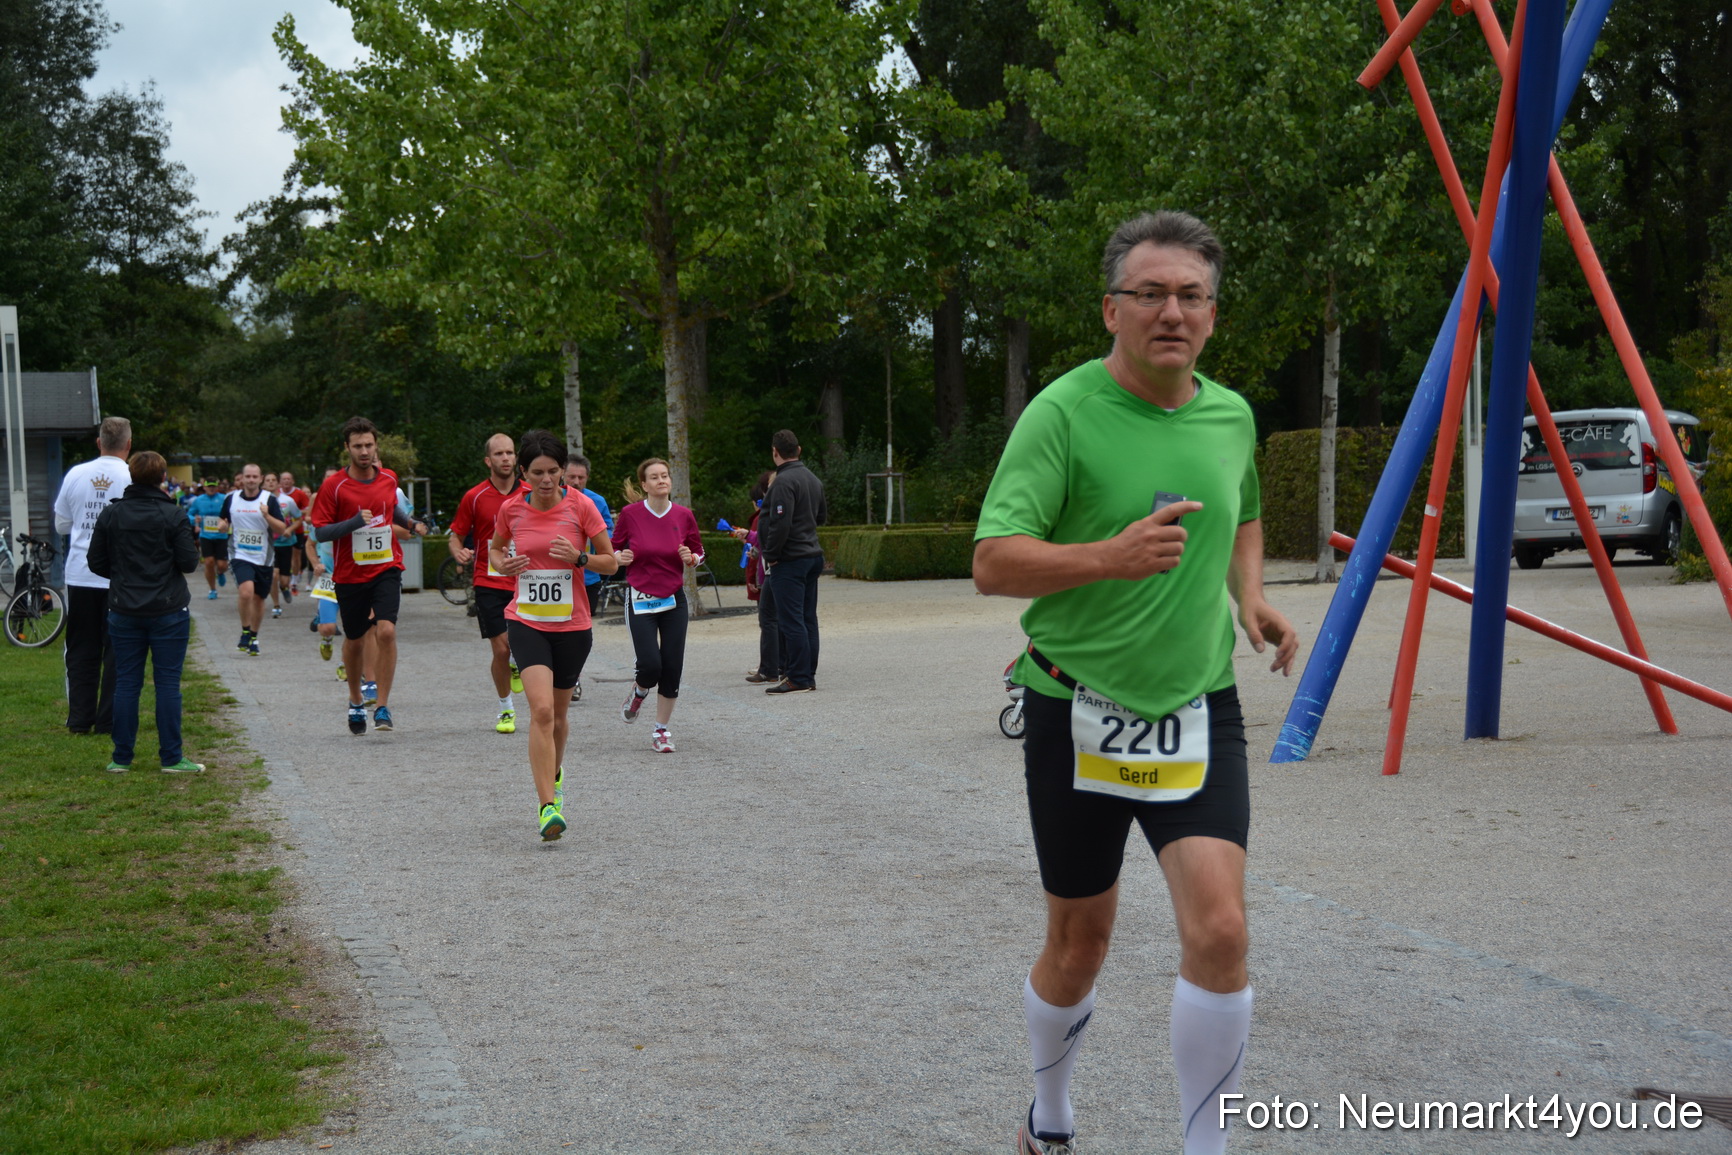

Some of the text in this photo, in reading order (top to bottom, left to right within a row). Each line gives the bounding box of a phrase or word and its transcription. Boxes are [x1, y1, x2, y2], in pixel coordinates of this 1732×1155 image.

[1535, 462, 1555, 471] LGS-P
[96, 491, 106, 499] IM
[239, 533, 262, 545] 2694
[366, 536, 383, 550] 15
[528, 582, 562, 602] 506
[1076, 693, 1120, 712] PARTL
[1099, 713, 1181, 756] 220
[1118, 766, 1159, 785] Gerd
